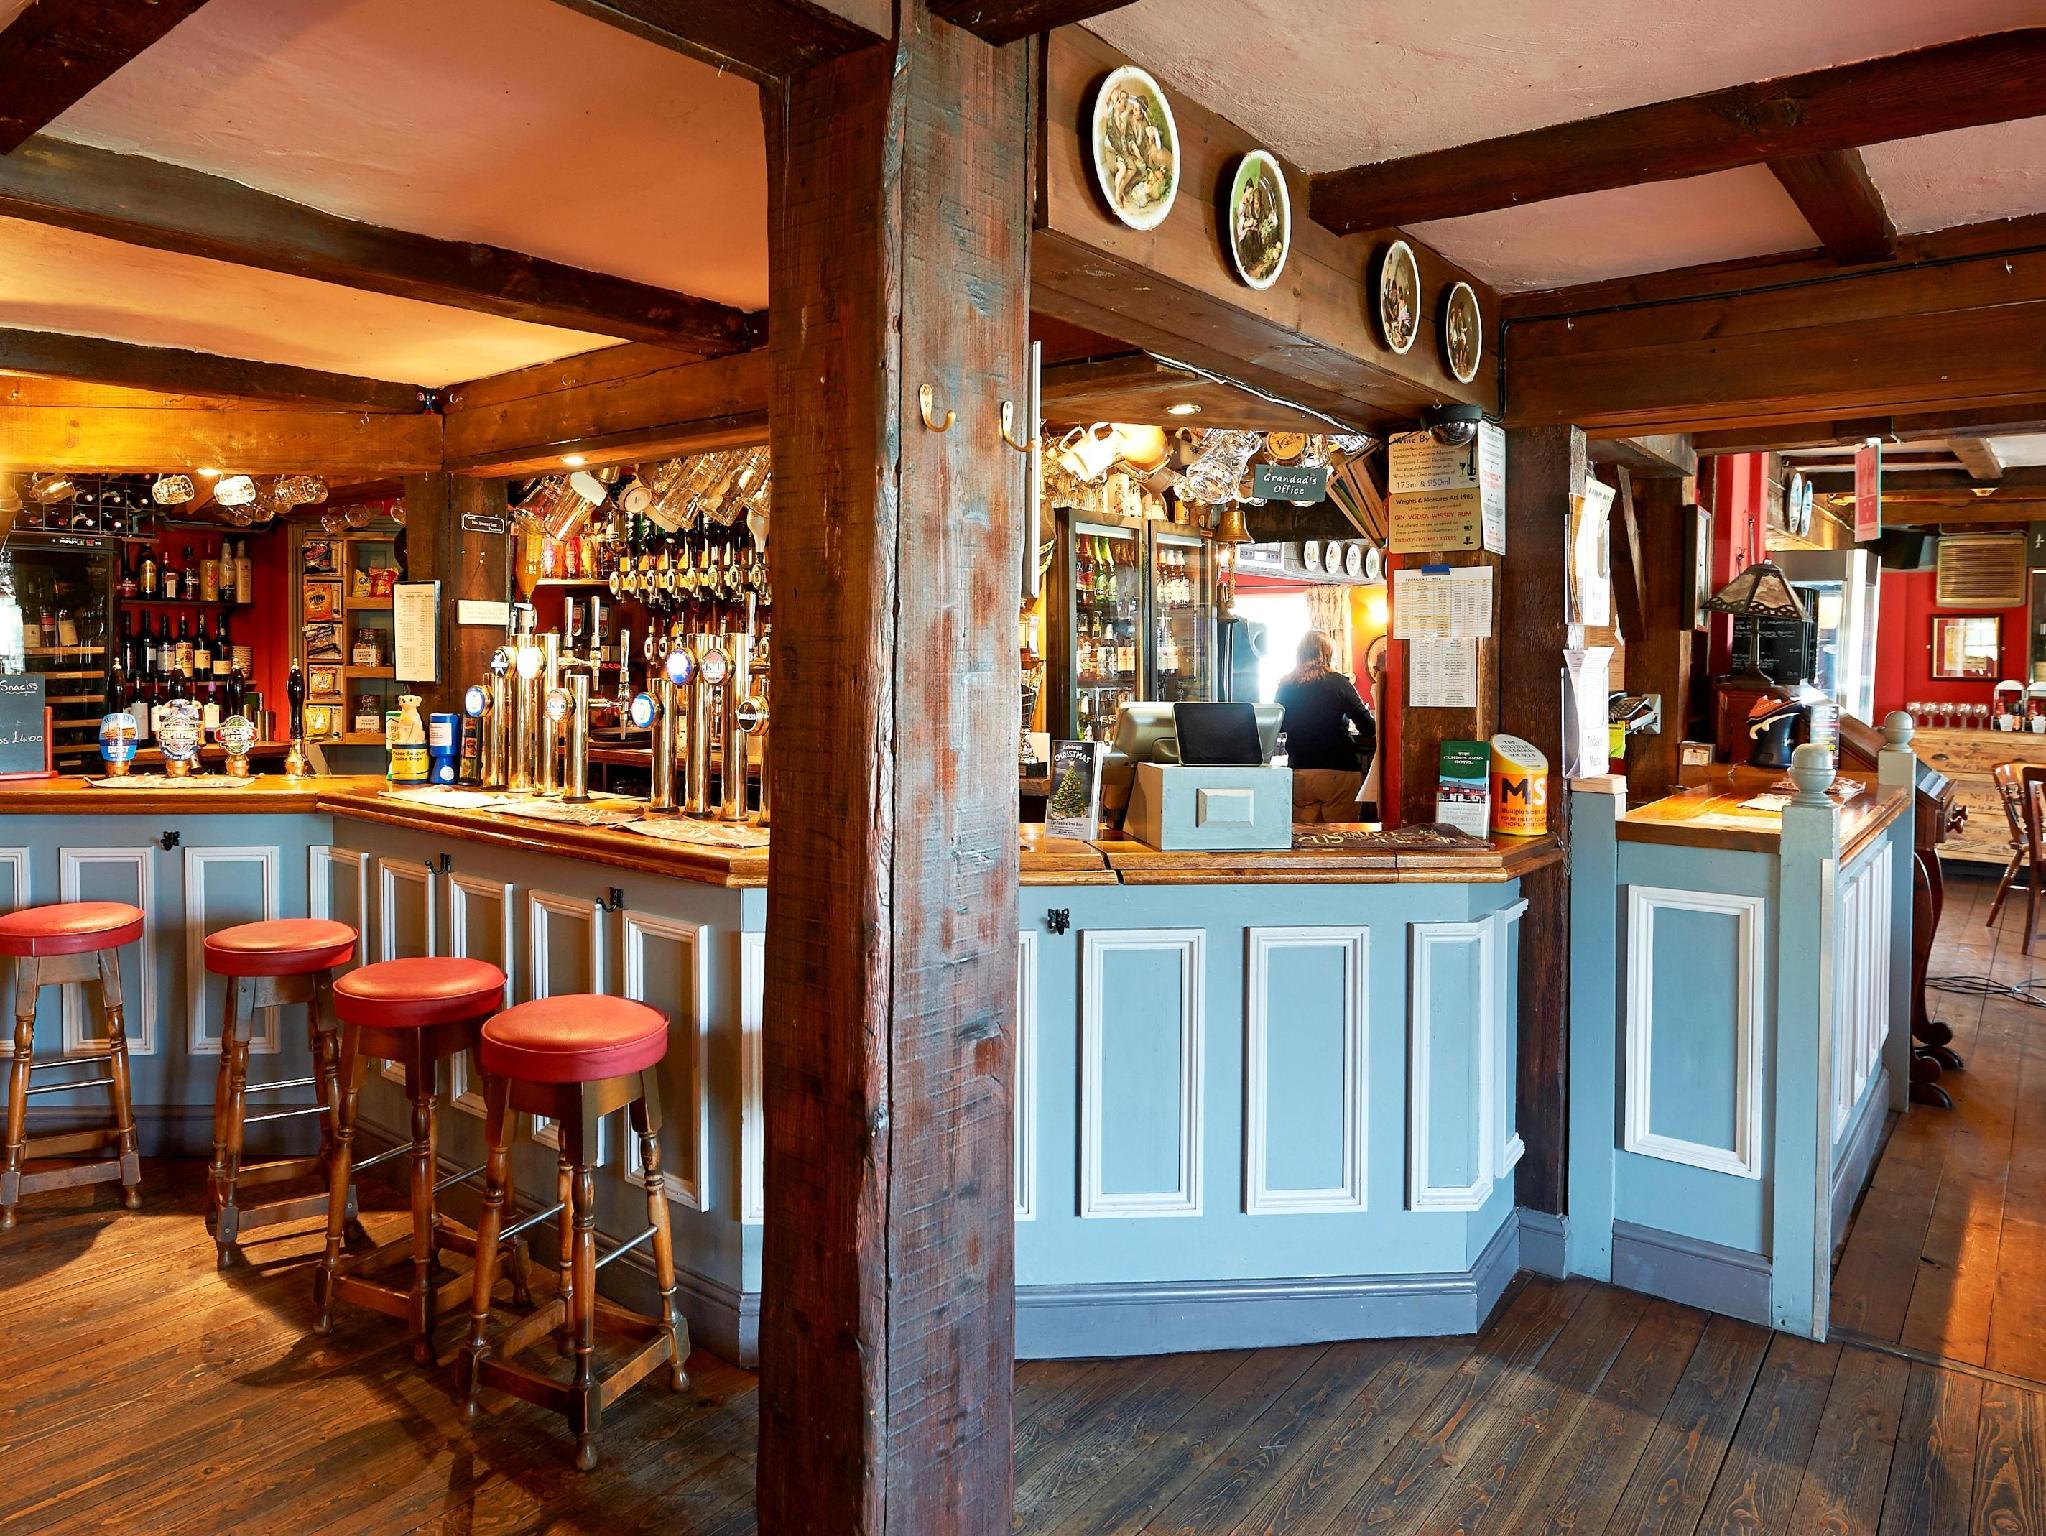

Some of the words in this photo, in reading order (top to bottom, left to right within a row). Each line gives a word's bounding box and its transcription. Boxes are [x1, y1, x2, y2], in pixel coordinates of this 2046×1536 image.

[1420, 434, 1430, 443] By
[1264, 472, 1317, 484] Grandad's
[1274, 484, 1305, 494] Office
[1054, 750, 1092, 764] CHRISTMAS
